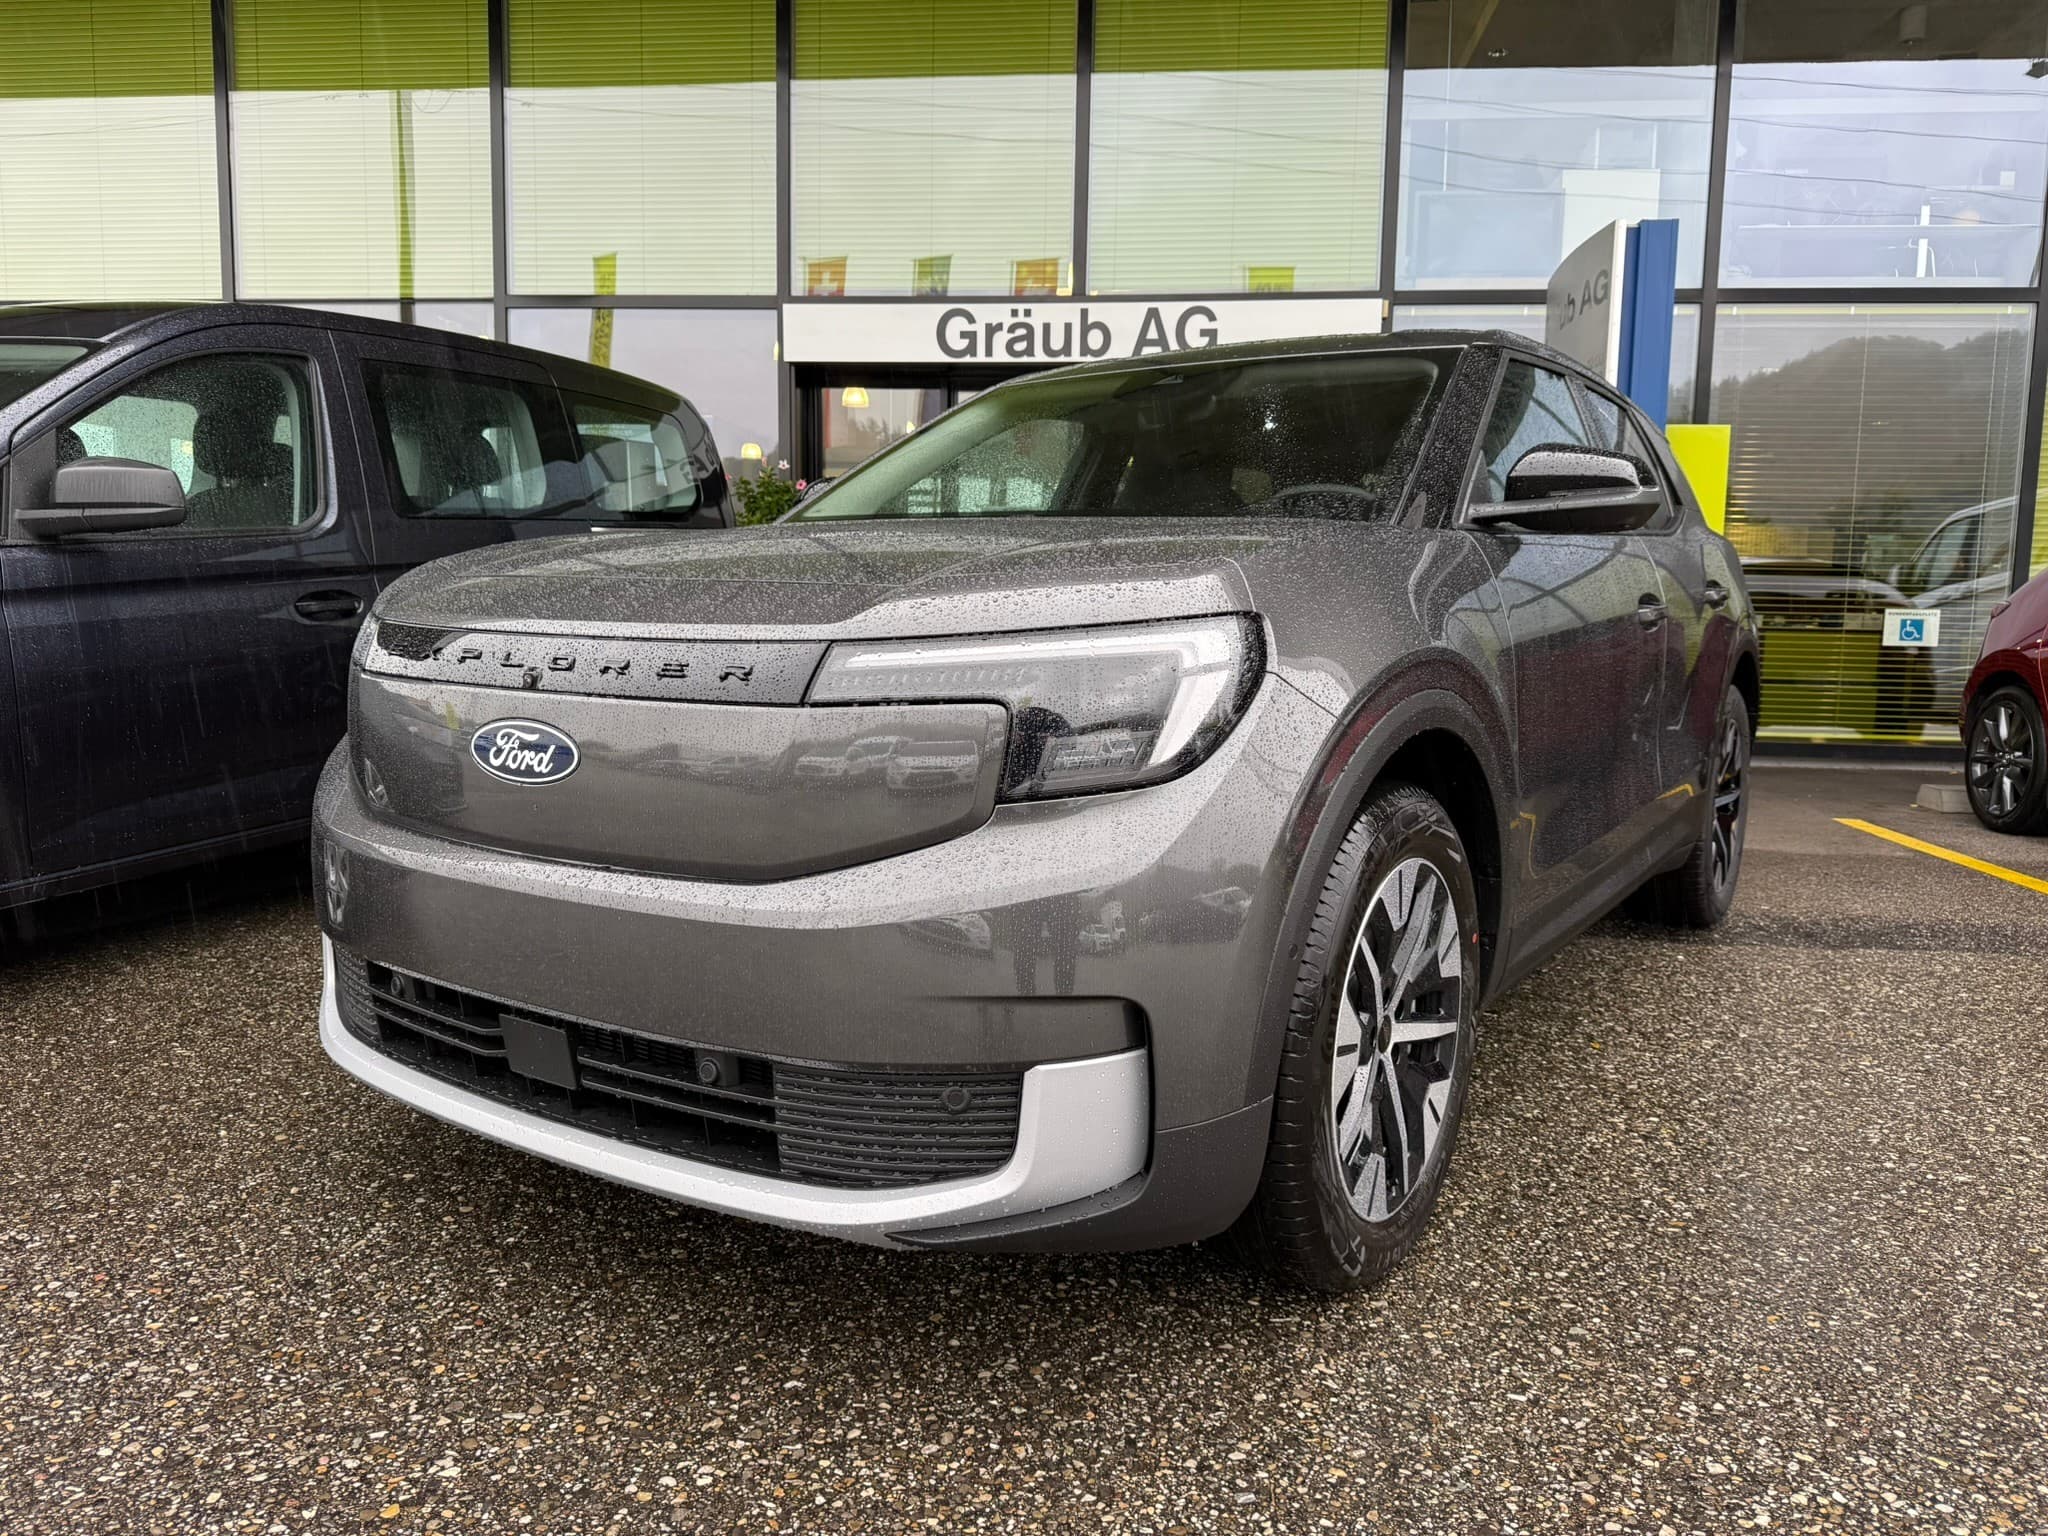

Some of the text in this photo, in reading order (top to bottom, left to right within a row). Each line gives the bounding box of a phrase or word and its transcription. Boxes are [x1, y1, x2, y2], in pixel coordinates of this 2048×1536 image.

[1579, 269, 1609, 316] AG
[936, 305, 1219, 359] Gräub AG
[489, 728, 556, 774] Ford
